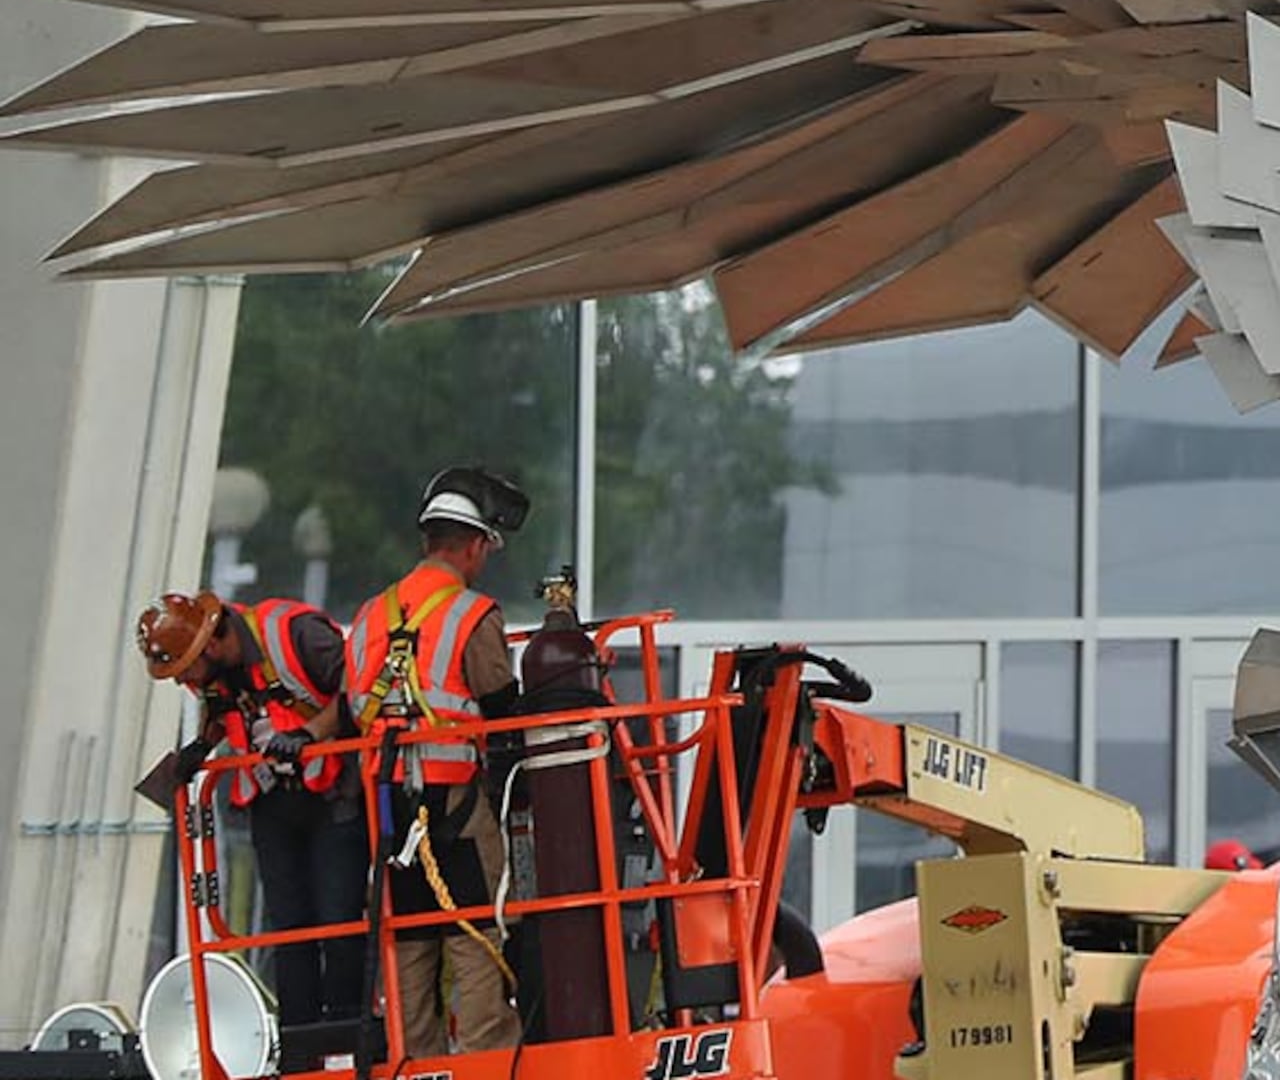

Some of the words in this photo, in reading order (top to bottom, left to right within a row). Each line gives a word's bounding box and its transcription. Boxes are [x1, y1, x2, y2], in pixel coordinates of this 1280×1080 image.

[923, 737, 951, 779] JLG
[954, 746, 987, 791] LIFT
[645, 1030, 731, 1080] JLG
[951, 1023, 1013, 1049] 179981
